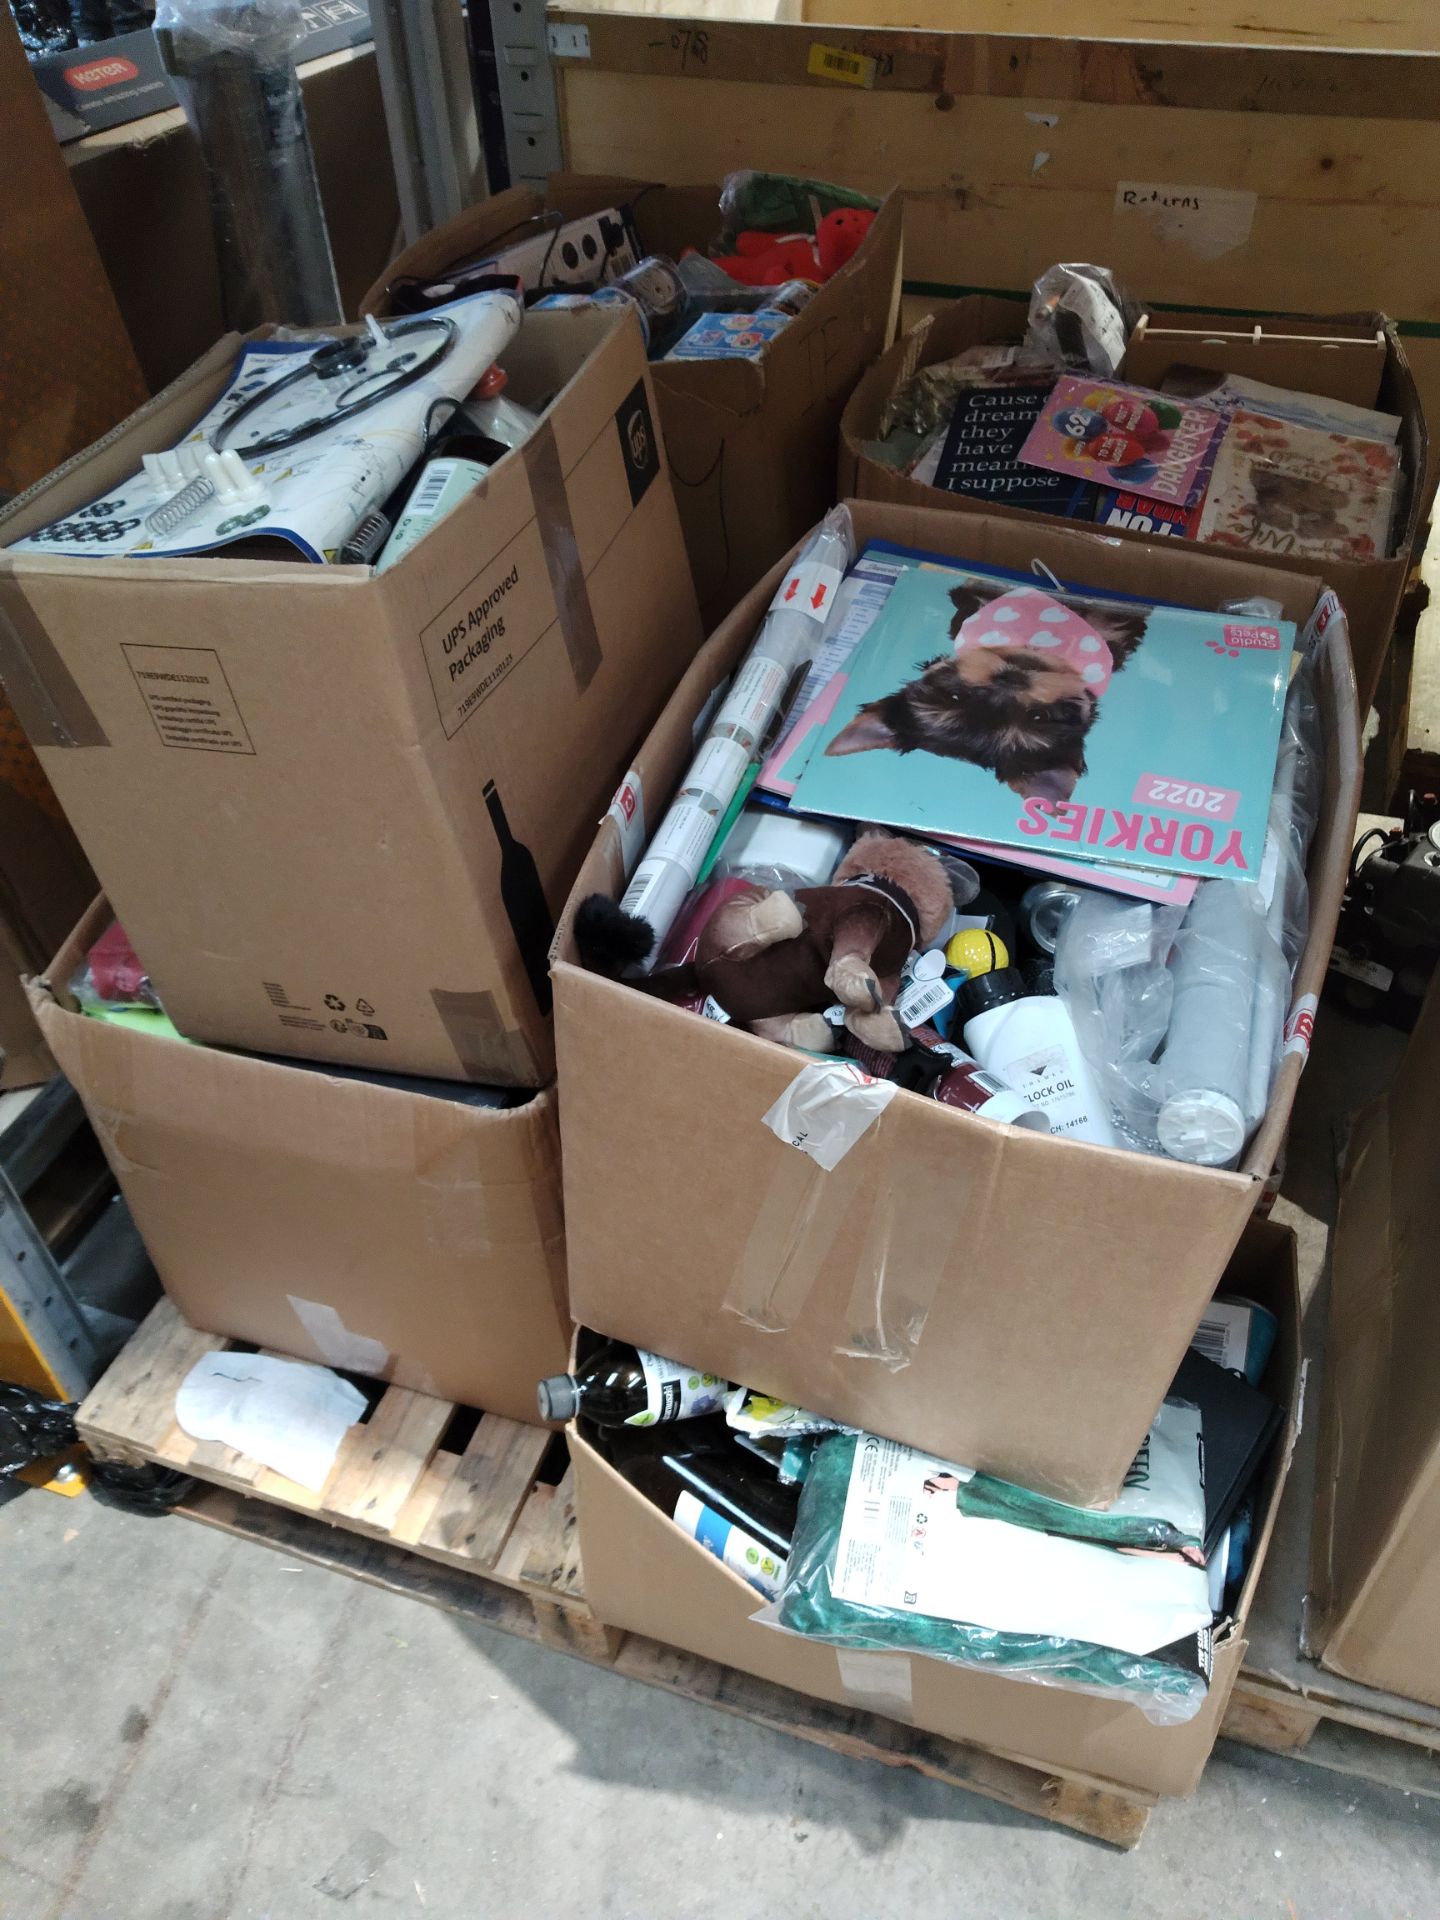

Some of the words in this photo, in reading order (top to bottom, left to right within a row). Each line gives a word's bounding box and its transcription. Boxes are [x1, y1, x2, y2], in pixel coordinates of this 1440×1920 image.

[969, 394, 1038, 407] Cause
[961, 425, 1014, 442] they
[1064, 414, 1092, 437] 62
[956, 442, 1013, 456] have
[1151, 410, 1209, 496] DAUGHTER
[947, 477, 956, 490] I
[961, 476, 1060, 492] suppose
[442, 620, 466, 654] UPS
[468, 565, 519, 630] Approved
[1230, 628, 1260, 638] Pets
[448, 617, 506, 682] Packaging
[1231, 637, 1277, 648] Studio
[1148, 780, 1226, 813] 2022
[1016, 797, 1249, 870] YORKIES
[1056, 1079, 1075, 1092] OIL
[791, 1131, 808, 1147] CAL
